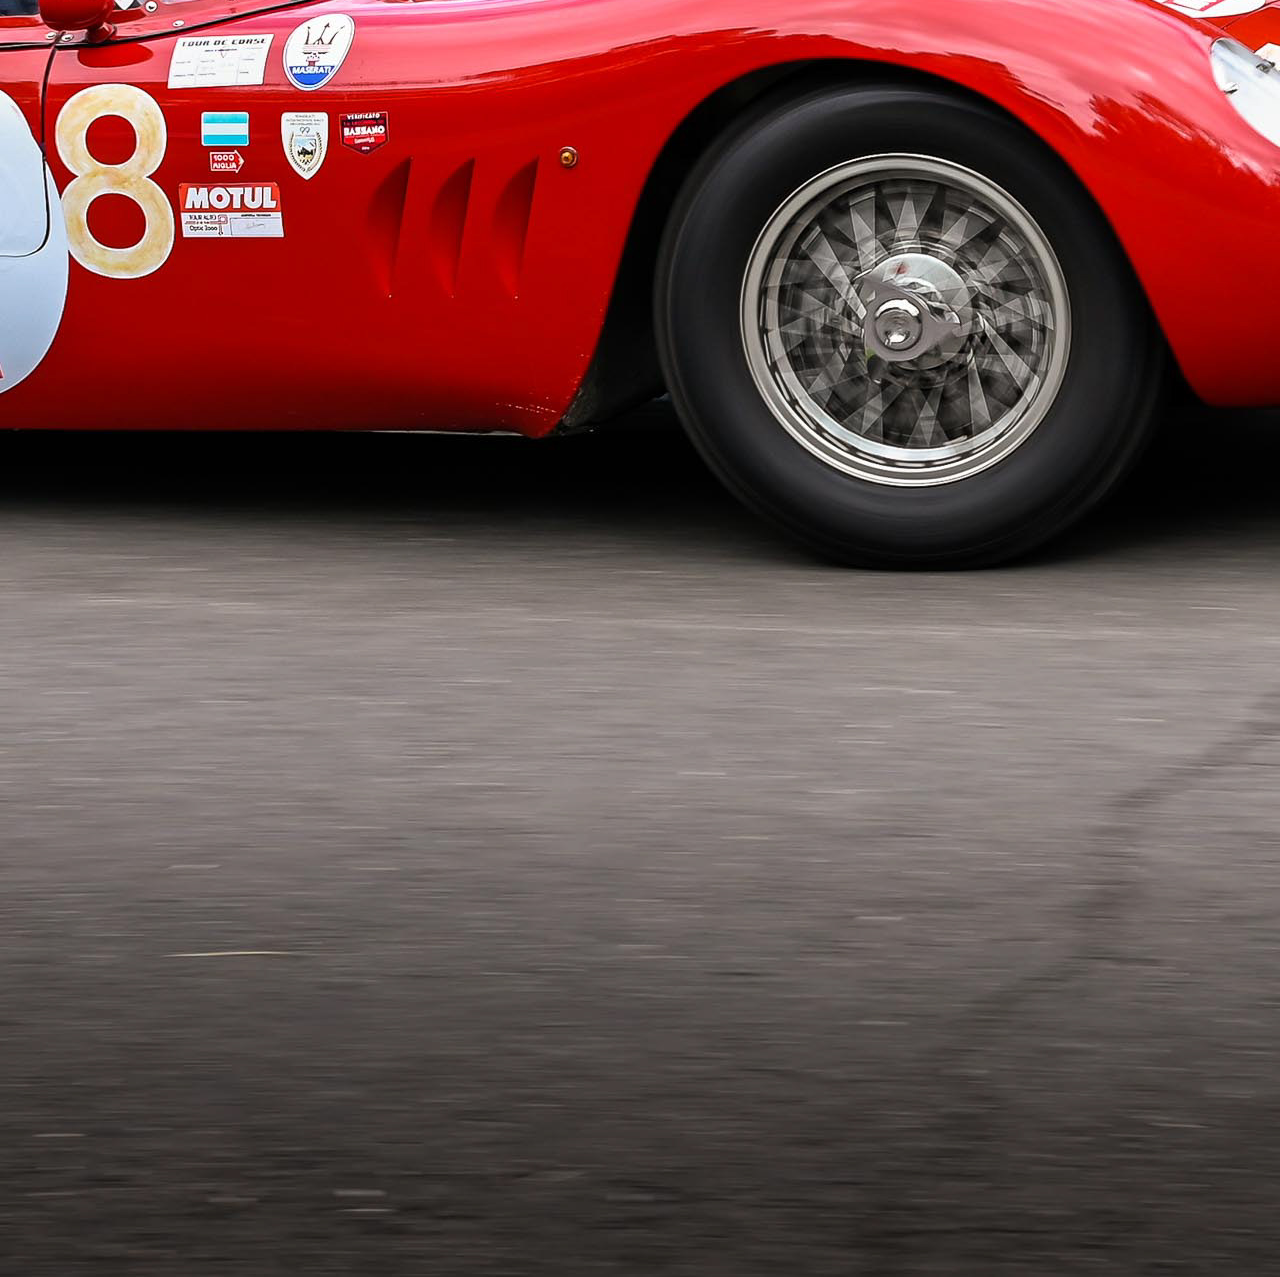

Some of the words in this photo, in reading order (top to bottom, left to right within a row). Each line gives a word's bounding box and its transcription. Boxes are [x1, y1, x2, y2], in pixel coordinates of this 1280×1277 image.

[292, 66, 331, 74] MASERATI
[344, 125, 385, 136] BASSANO
[55, 83, 175, 279] 8
[184, 186, 277, 209] MOTUL
